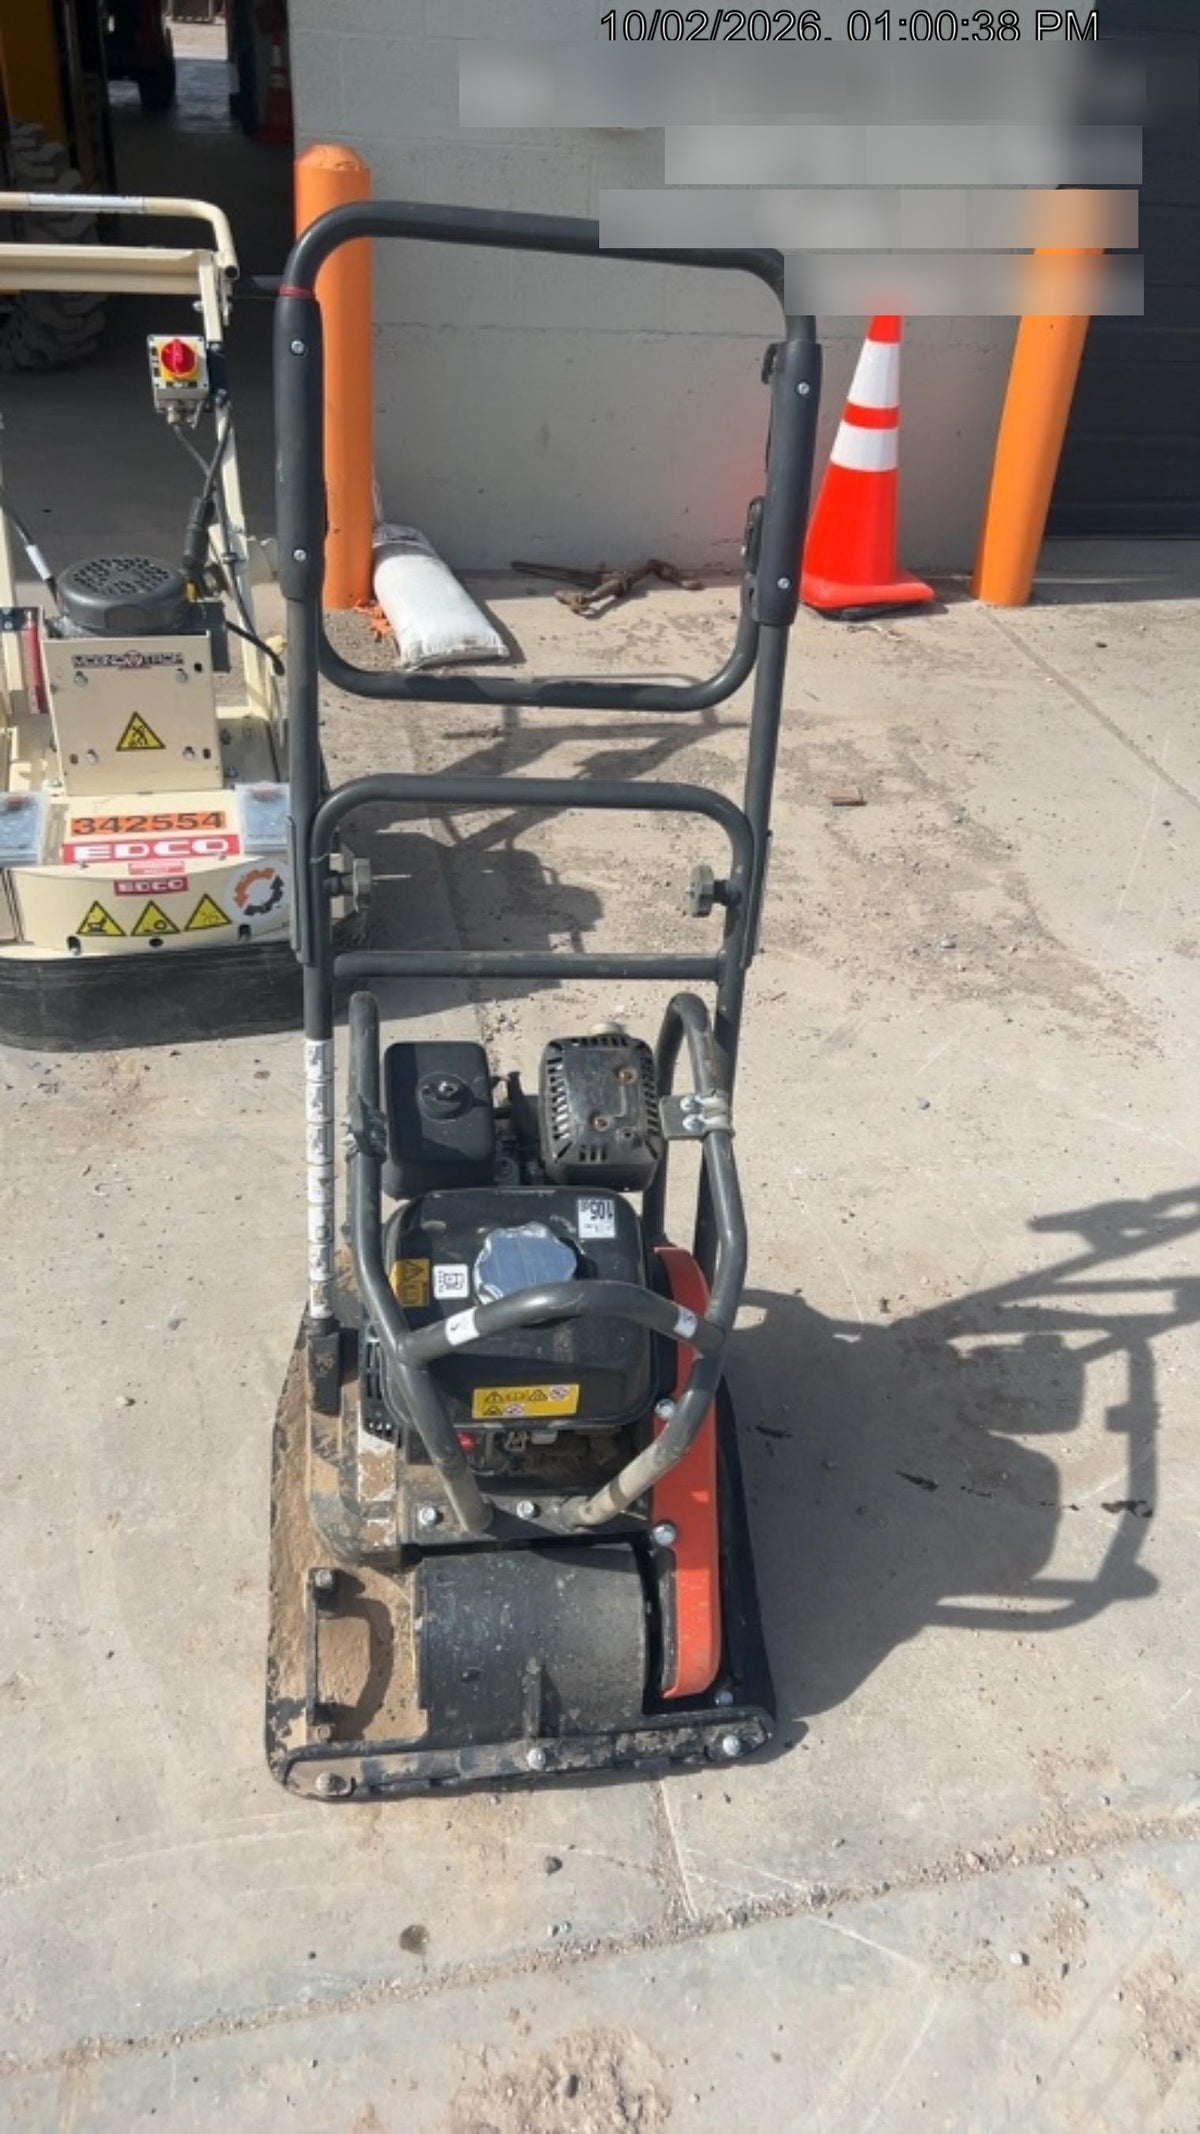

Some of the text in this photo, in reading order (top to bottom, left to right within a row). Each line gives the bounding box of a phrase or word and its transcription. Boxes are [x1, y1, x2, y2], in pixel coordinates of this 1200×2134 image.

[73, 812, 223, 835] 342554
[73, 838, 229, 861] EDCO
[117, 879, 184, 893] EDCO
